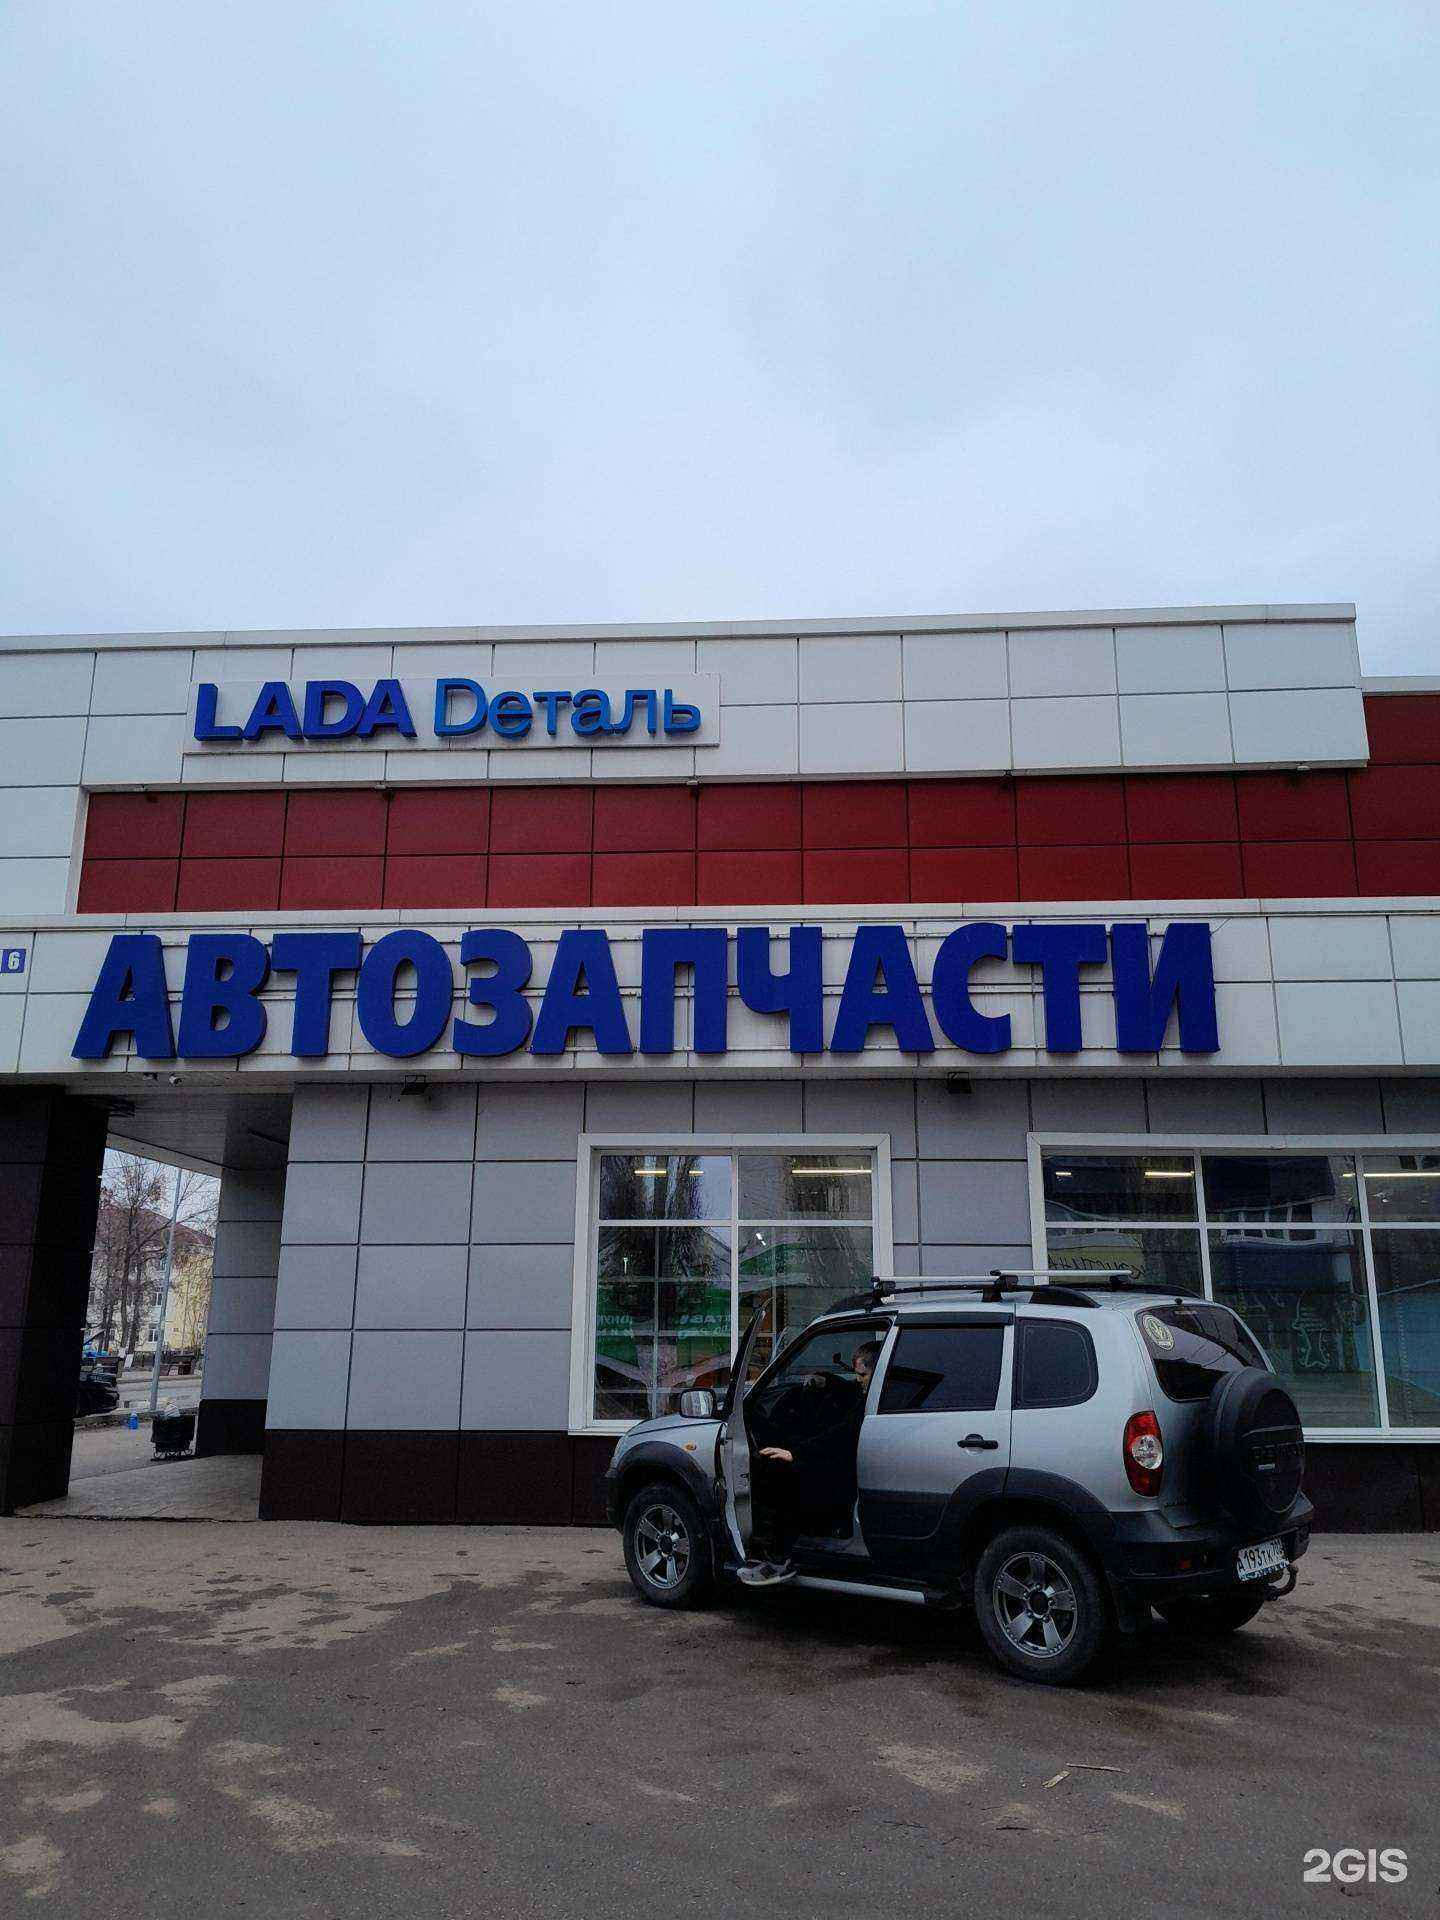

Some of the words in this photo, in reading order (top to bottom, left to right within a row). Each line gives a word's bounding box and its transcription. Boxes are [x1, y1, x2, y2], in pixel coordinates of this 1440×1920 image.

[194, 678, 417, 741] LADA
[7, 951, 21, 970] 6
[72, 922, 1220, 1060] АВТОЗАПЧАСТИ
